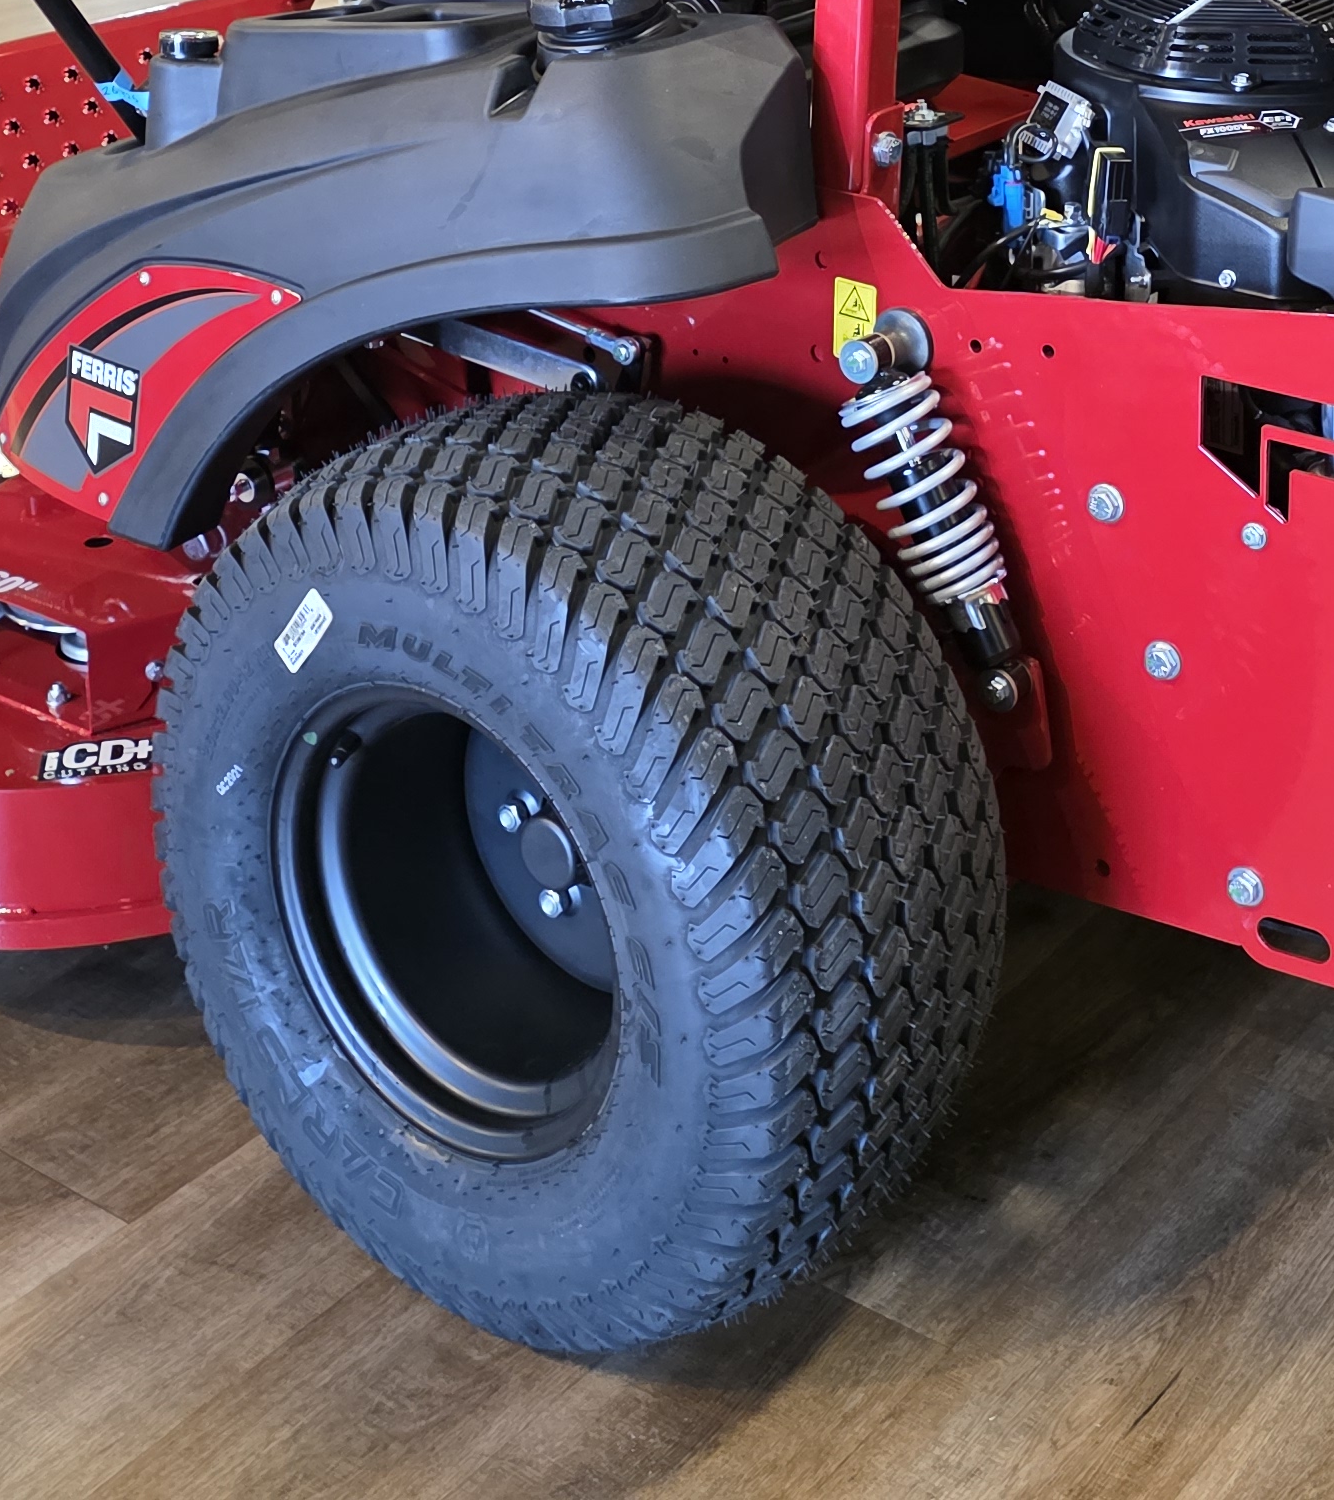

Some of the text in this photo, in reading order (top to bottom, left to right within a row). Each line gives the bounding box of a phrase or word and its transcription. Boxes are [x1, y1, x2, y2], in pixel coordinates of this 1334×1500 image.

[1183, 113, 1256, 128] Kawasaki
[72, 350, 137, 396] FERRIS
[357, 621, 514, 717] MULTI
[43, 761, 146, 779] CUTTING
